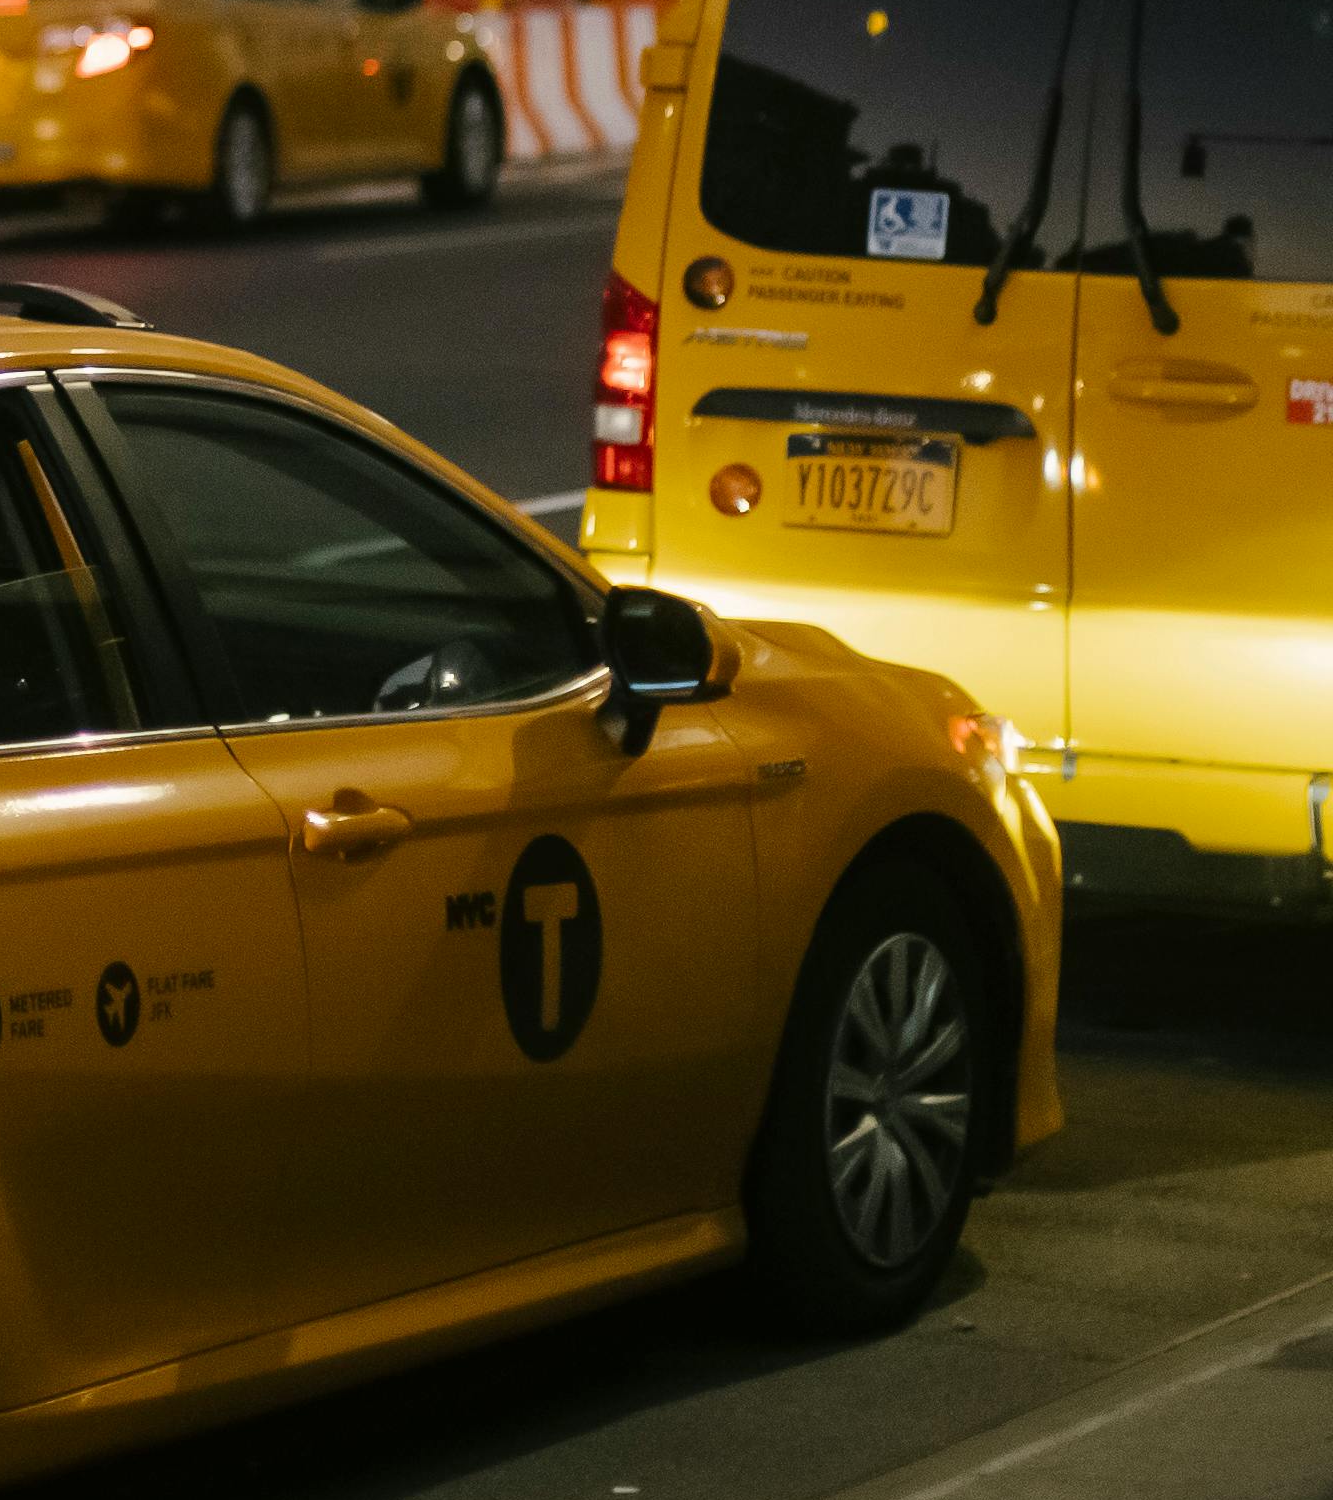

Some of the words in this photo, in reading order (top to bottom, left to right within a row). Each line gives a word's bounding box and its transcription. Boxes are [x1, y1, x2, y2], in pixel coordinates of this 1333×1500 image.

[797, 462, 935, 516] Y103729C
[444, 891, 497, 931] NYC
[523, 883, 579, 1032] T
[147, 974, 179, 996] FLAT
[182, 969, 215, 991] FARE
[9, 988, 73, 1013] METERED
[148, 1001, 174, 1022] JFK
[10, 1018, 46, 1040] FARE
